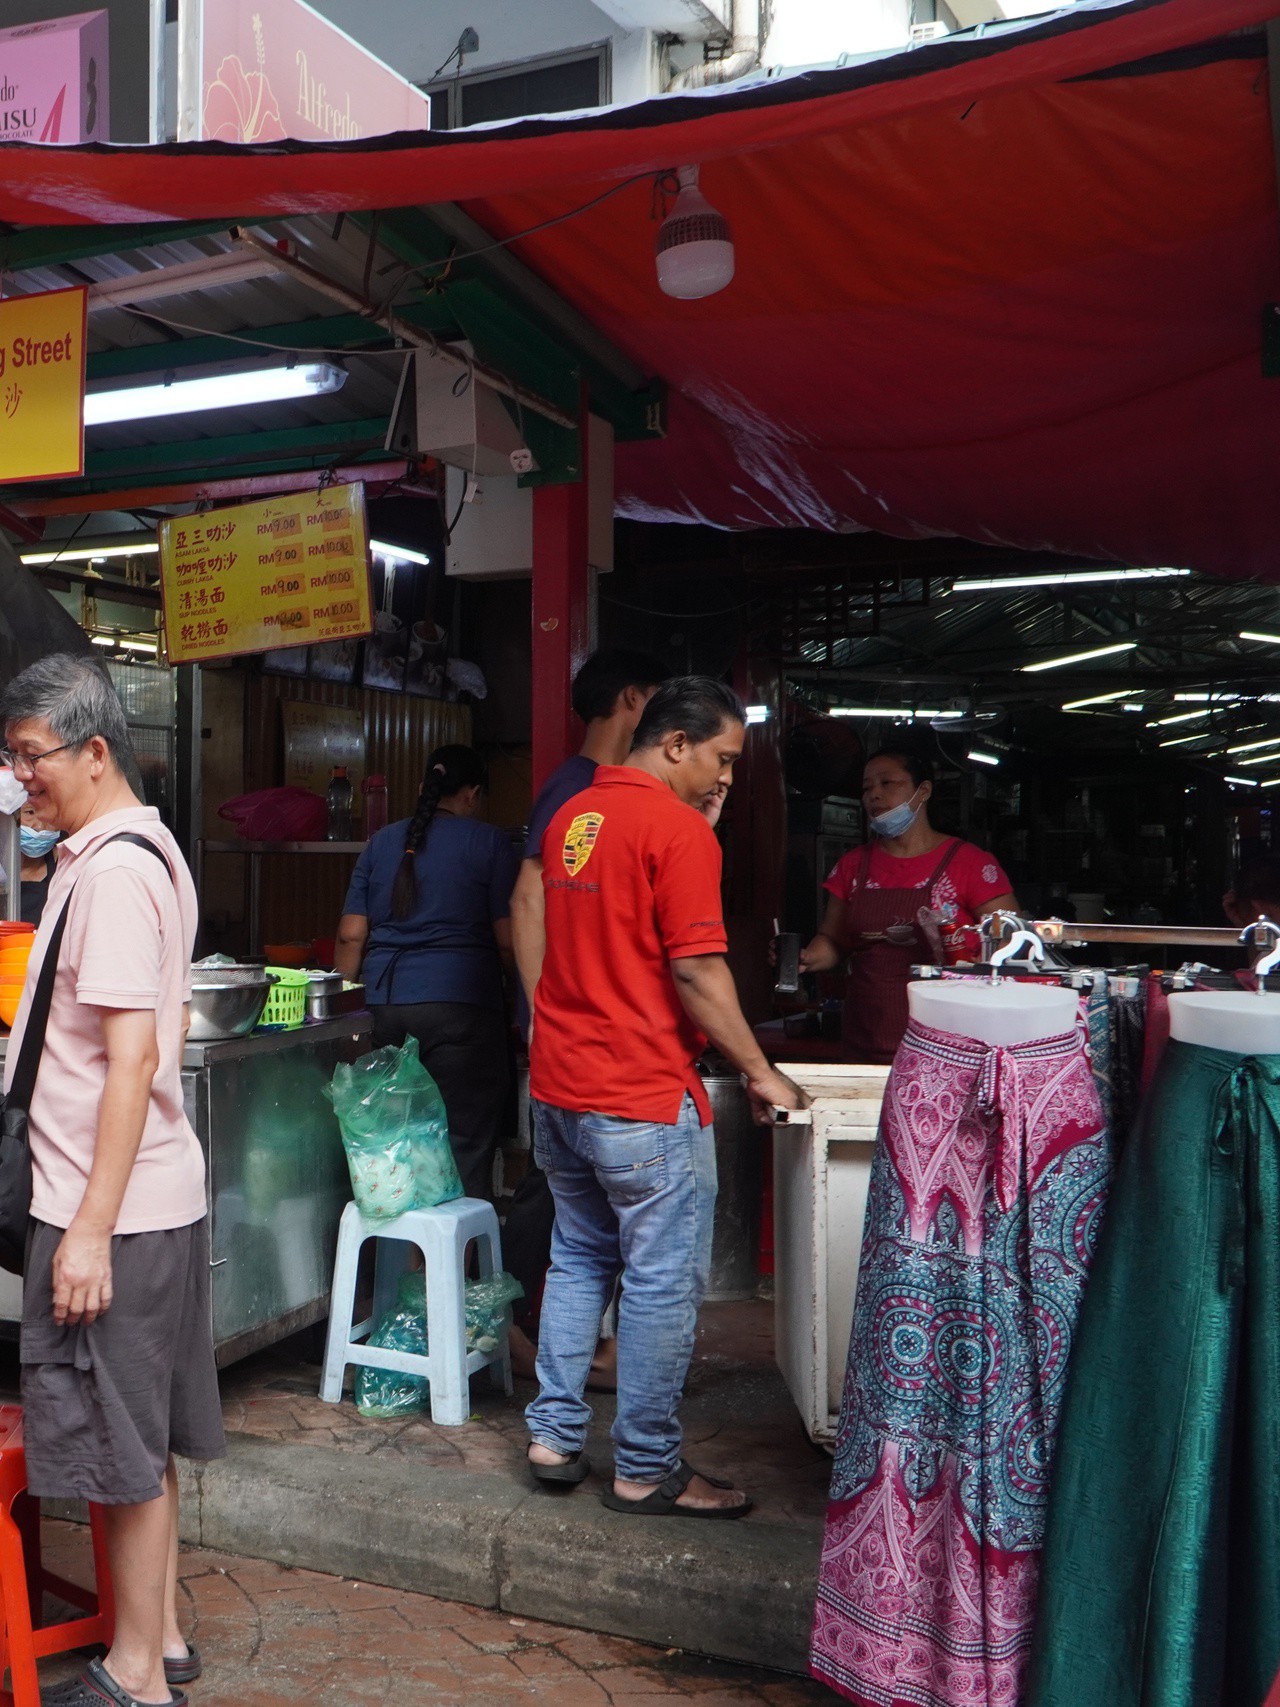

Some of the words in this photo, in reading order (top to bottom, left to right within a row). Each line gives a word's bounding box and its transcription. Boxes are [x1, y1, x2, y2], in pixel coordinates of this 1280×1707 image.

[296, 49, 360, 141] Alfredo
[12, 332, 72, 368] Street
[175, 521, 236, 550] 亞三叻沙
